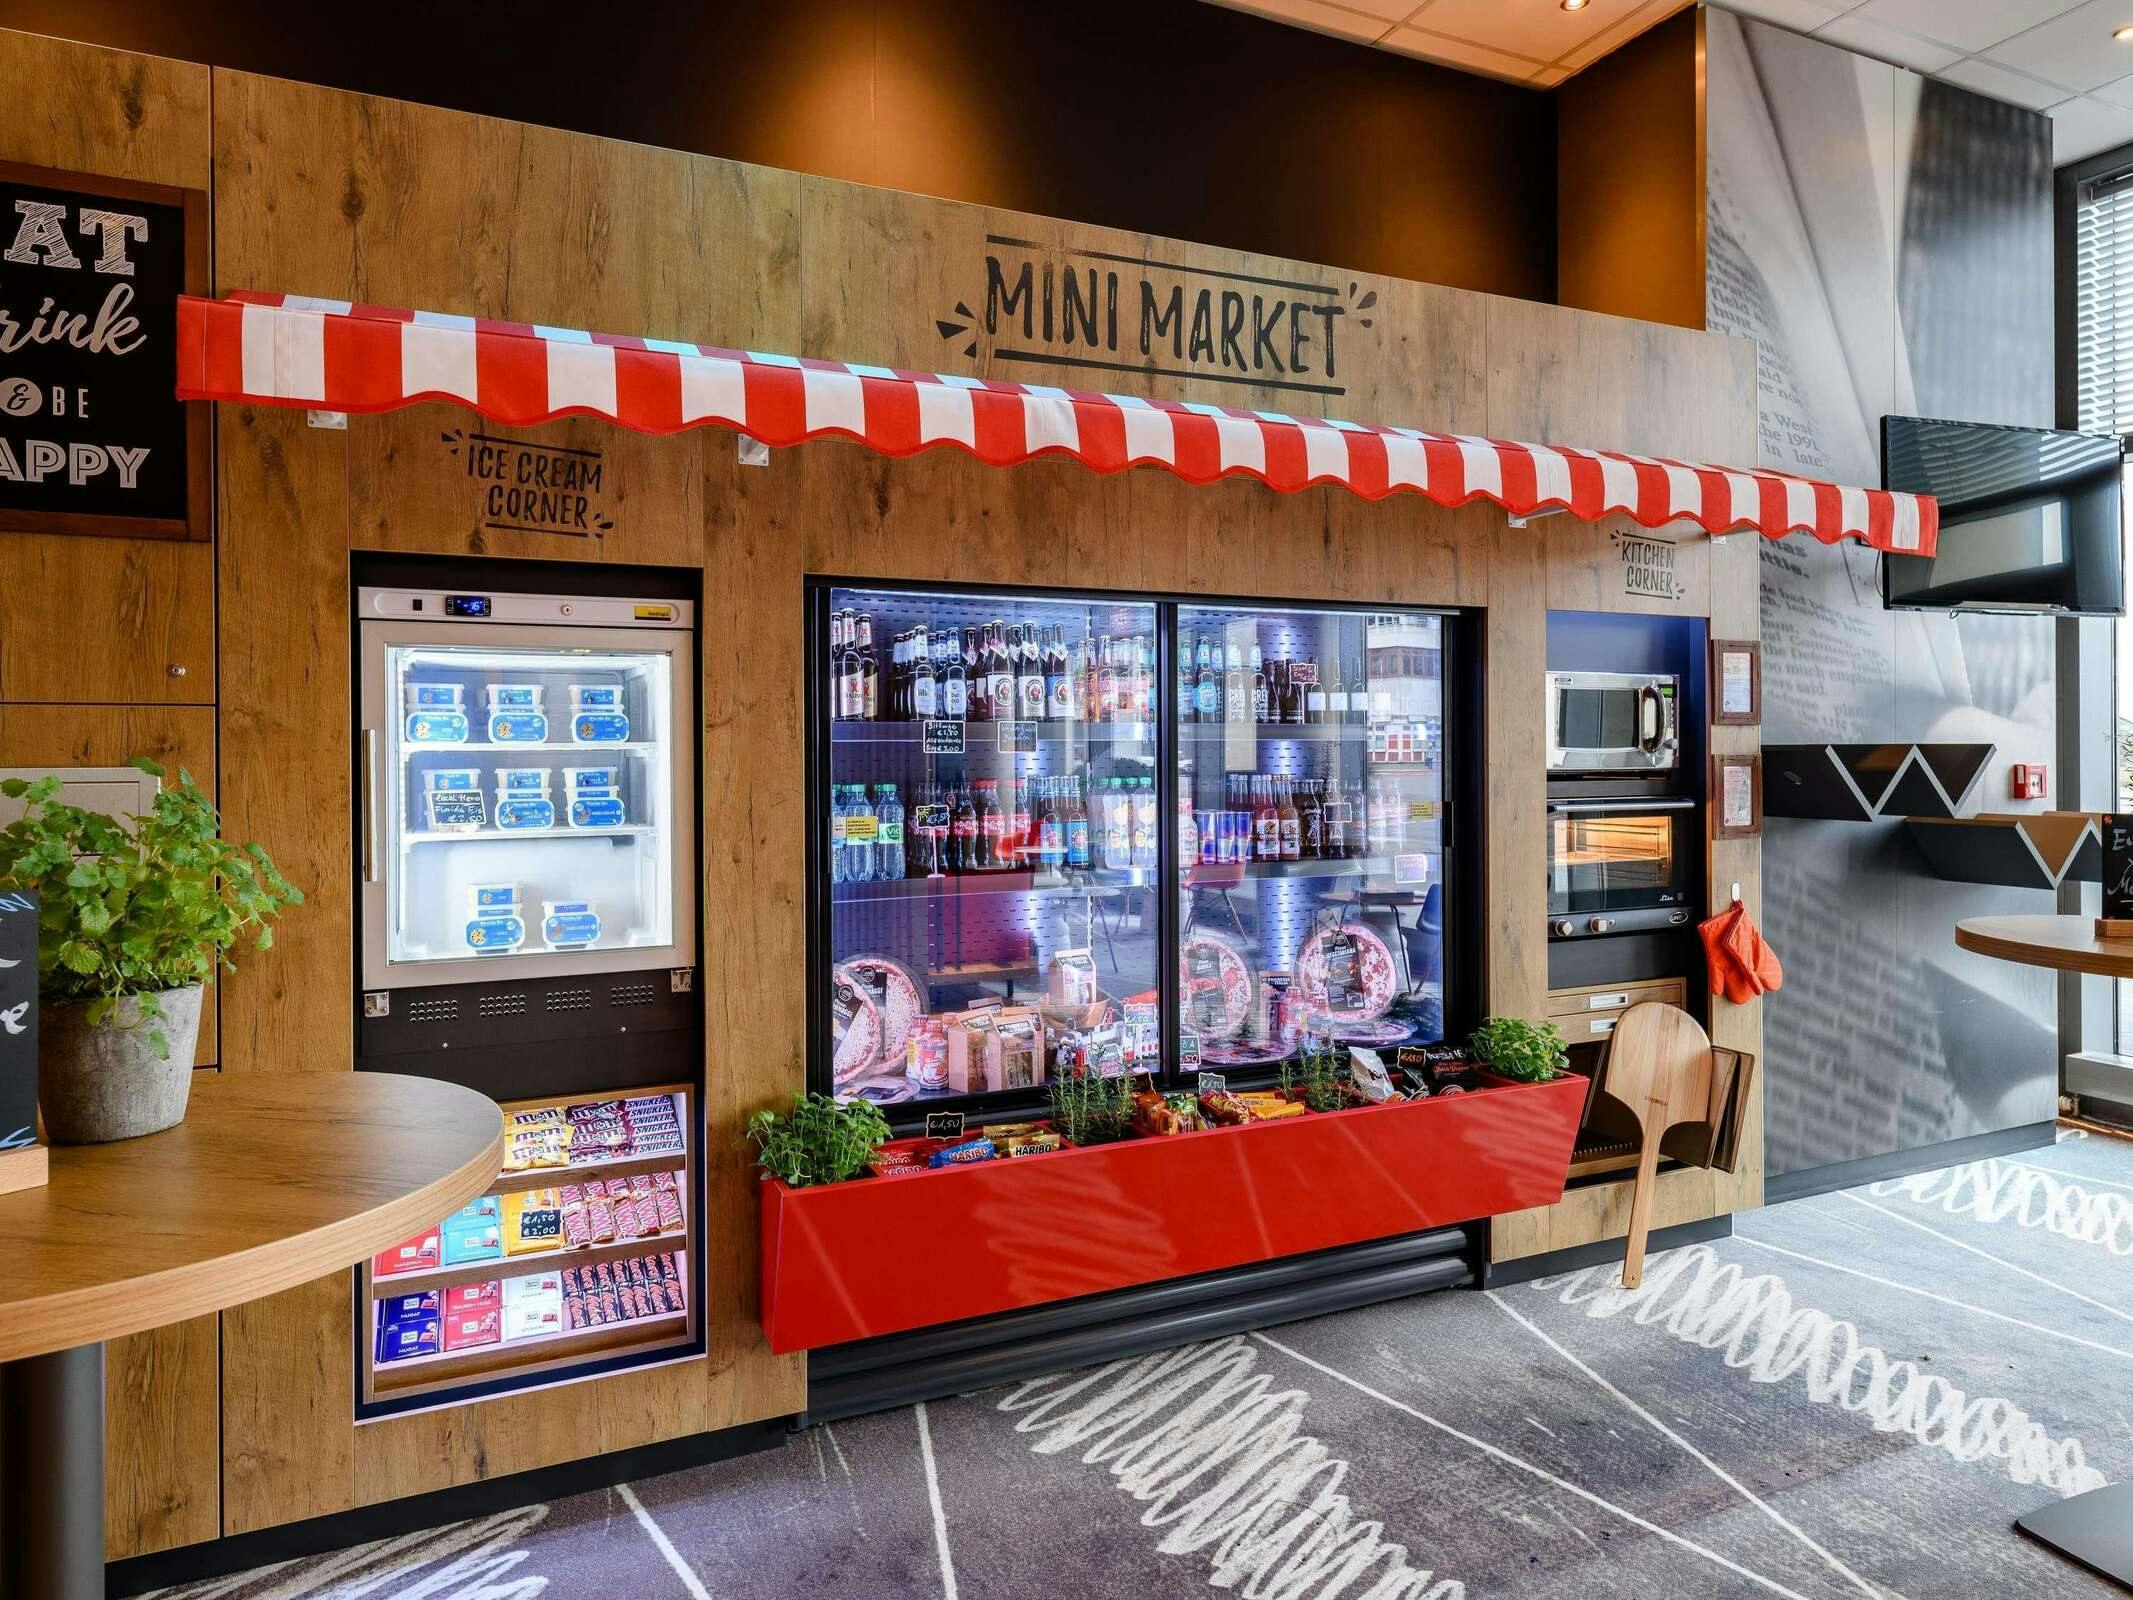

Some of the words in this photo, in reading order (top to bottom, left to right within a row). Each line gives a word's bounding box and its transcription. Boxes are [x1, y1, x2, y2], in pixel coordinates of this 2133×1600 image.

[986, 256, 1118, 351] MINI
[1139, 281, 1345, 377] MARKET
[53, 386, 88, 418] BE
[468, 444, 508, 480] ICE
[517, 452, 602, 493] CREAM
[487, 484, 587, 529] CORNER
[1622, 540, 1676, 569] KITCHEN
[1626, 565, 1673, 594] CORNER
[949, 1146, 989, 1162] HARIBO
[1015, 1143, 1052, 1157] HARIBO
